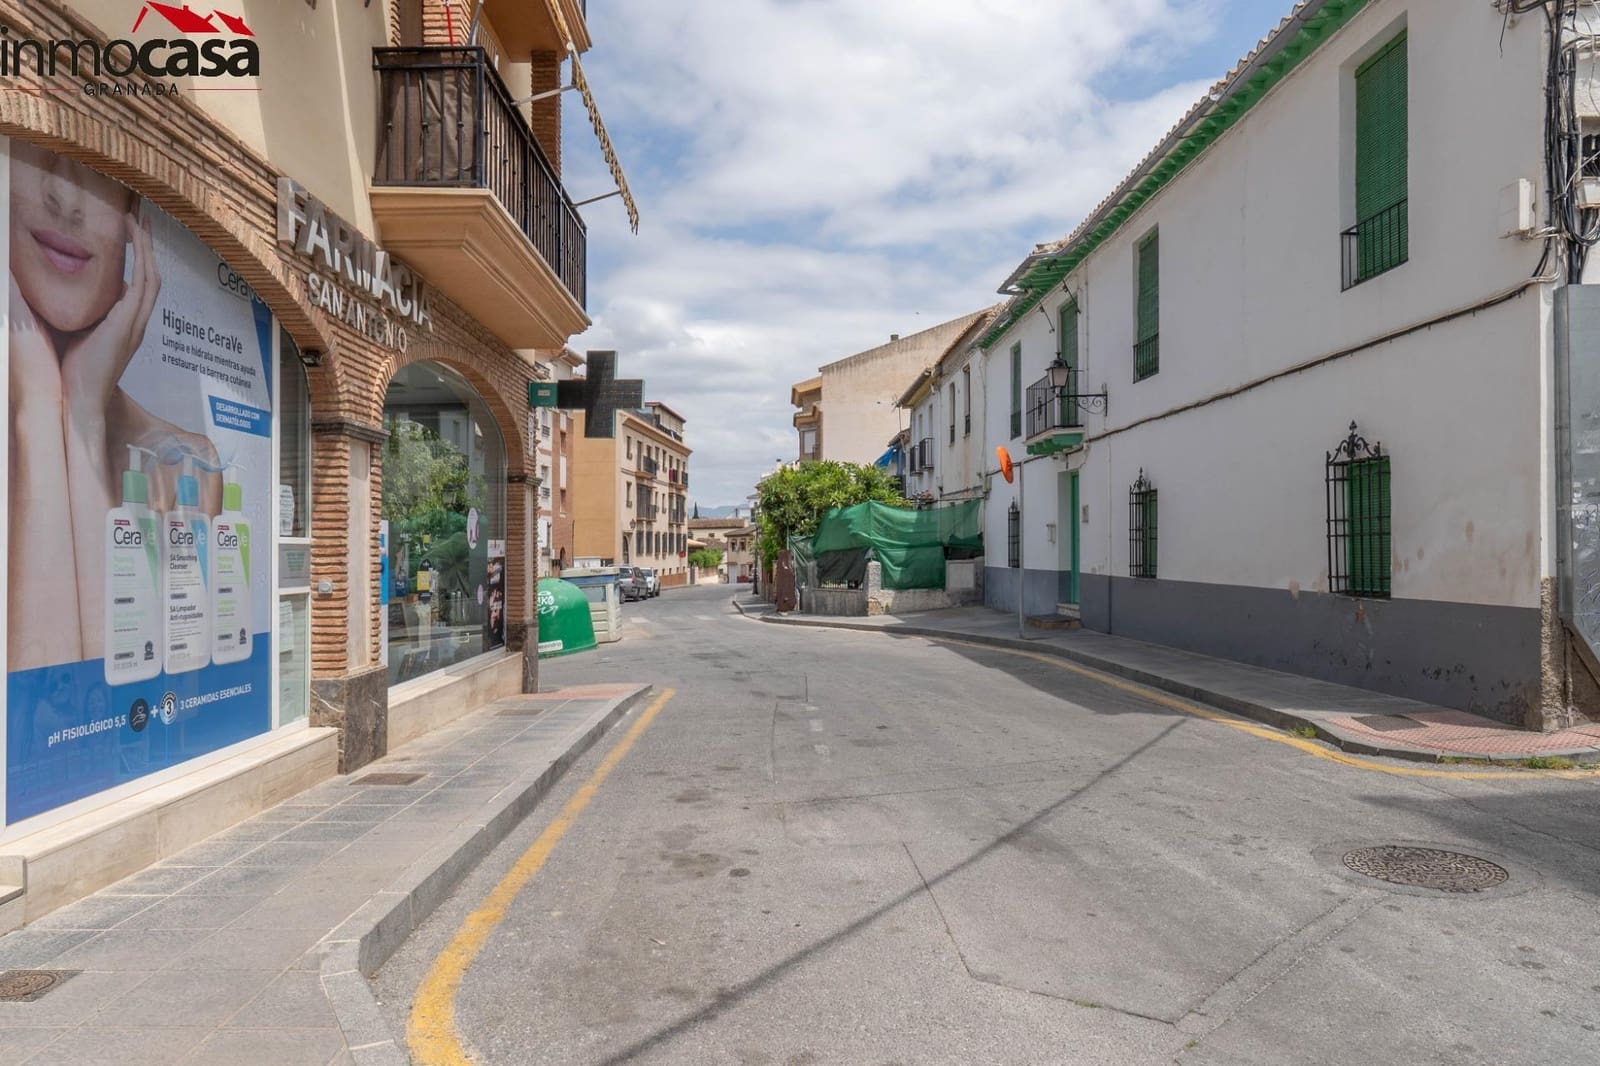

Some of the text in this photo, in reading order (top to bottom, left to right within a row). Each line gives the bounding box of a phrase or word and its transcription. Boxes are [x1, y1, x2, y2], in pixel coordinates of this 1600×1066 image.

[277, 176, 433, 333] FARMACIA
[163, 308, 243, 354] Higiene CeraVe
[308, 272, 407, 353] SAN ANTONIO
[162, 334, 256, 376] Limpia e hidrata mientras ayuda
[162, 353, 167, 362] a
[168, 355, 198, 372] restaurar
[200, 363, 206, 375] la
[207, 365, 229, 382] barrera
[185, 691, 219, 709] CERAMIDAS
[220, 683, 252, 699] ESENCIALES
[48, 715, 127, 748] pH FISIOLÓGICO 5,5
